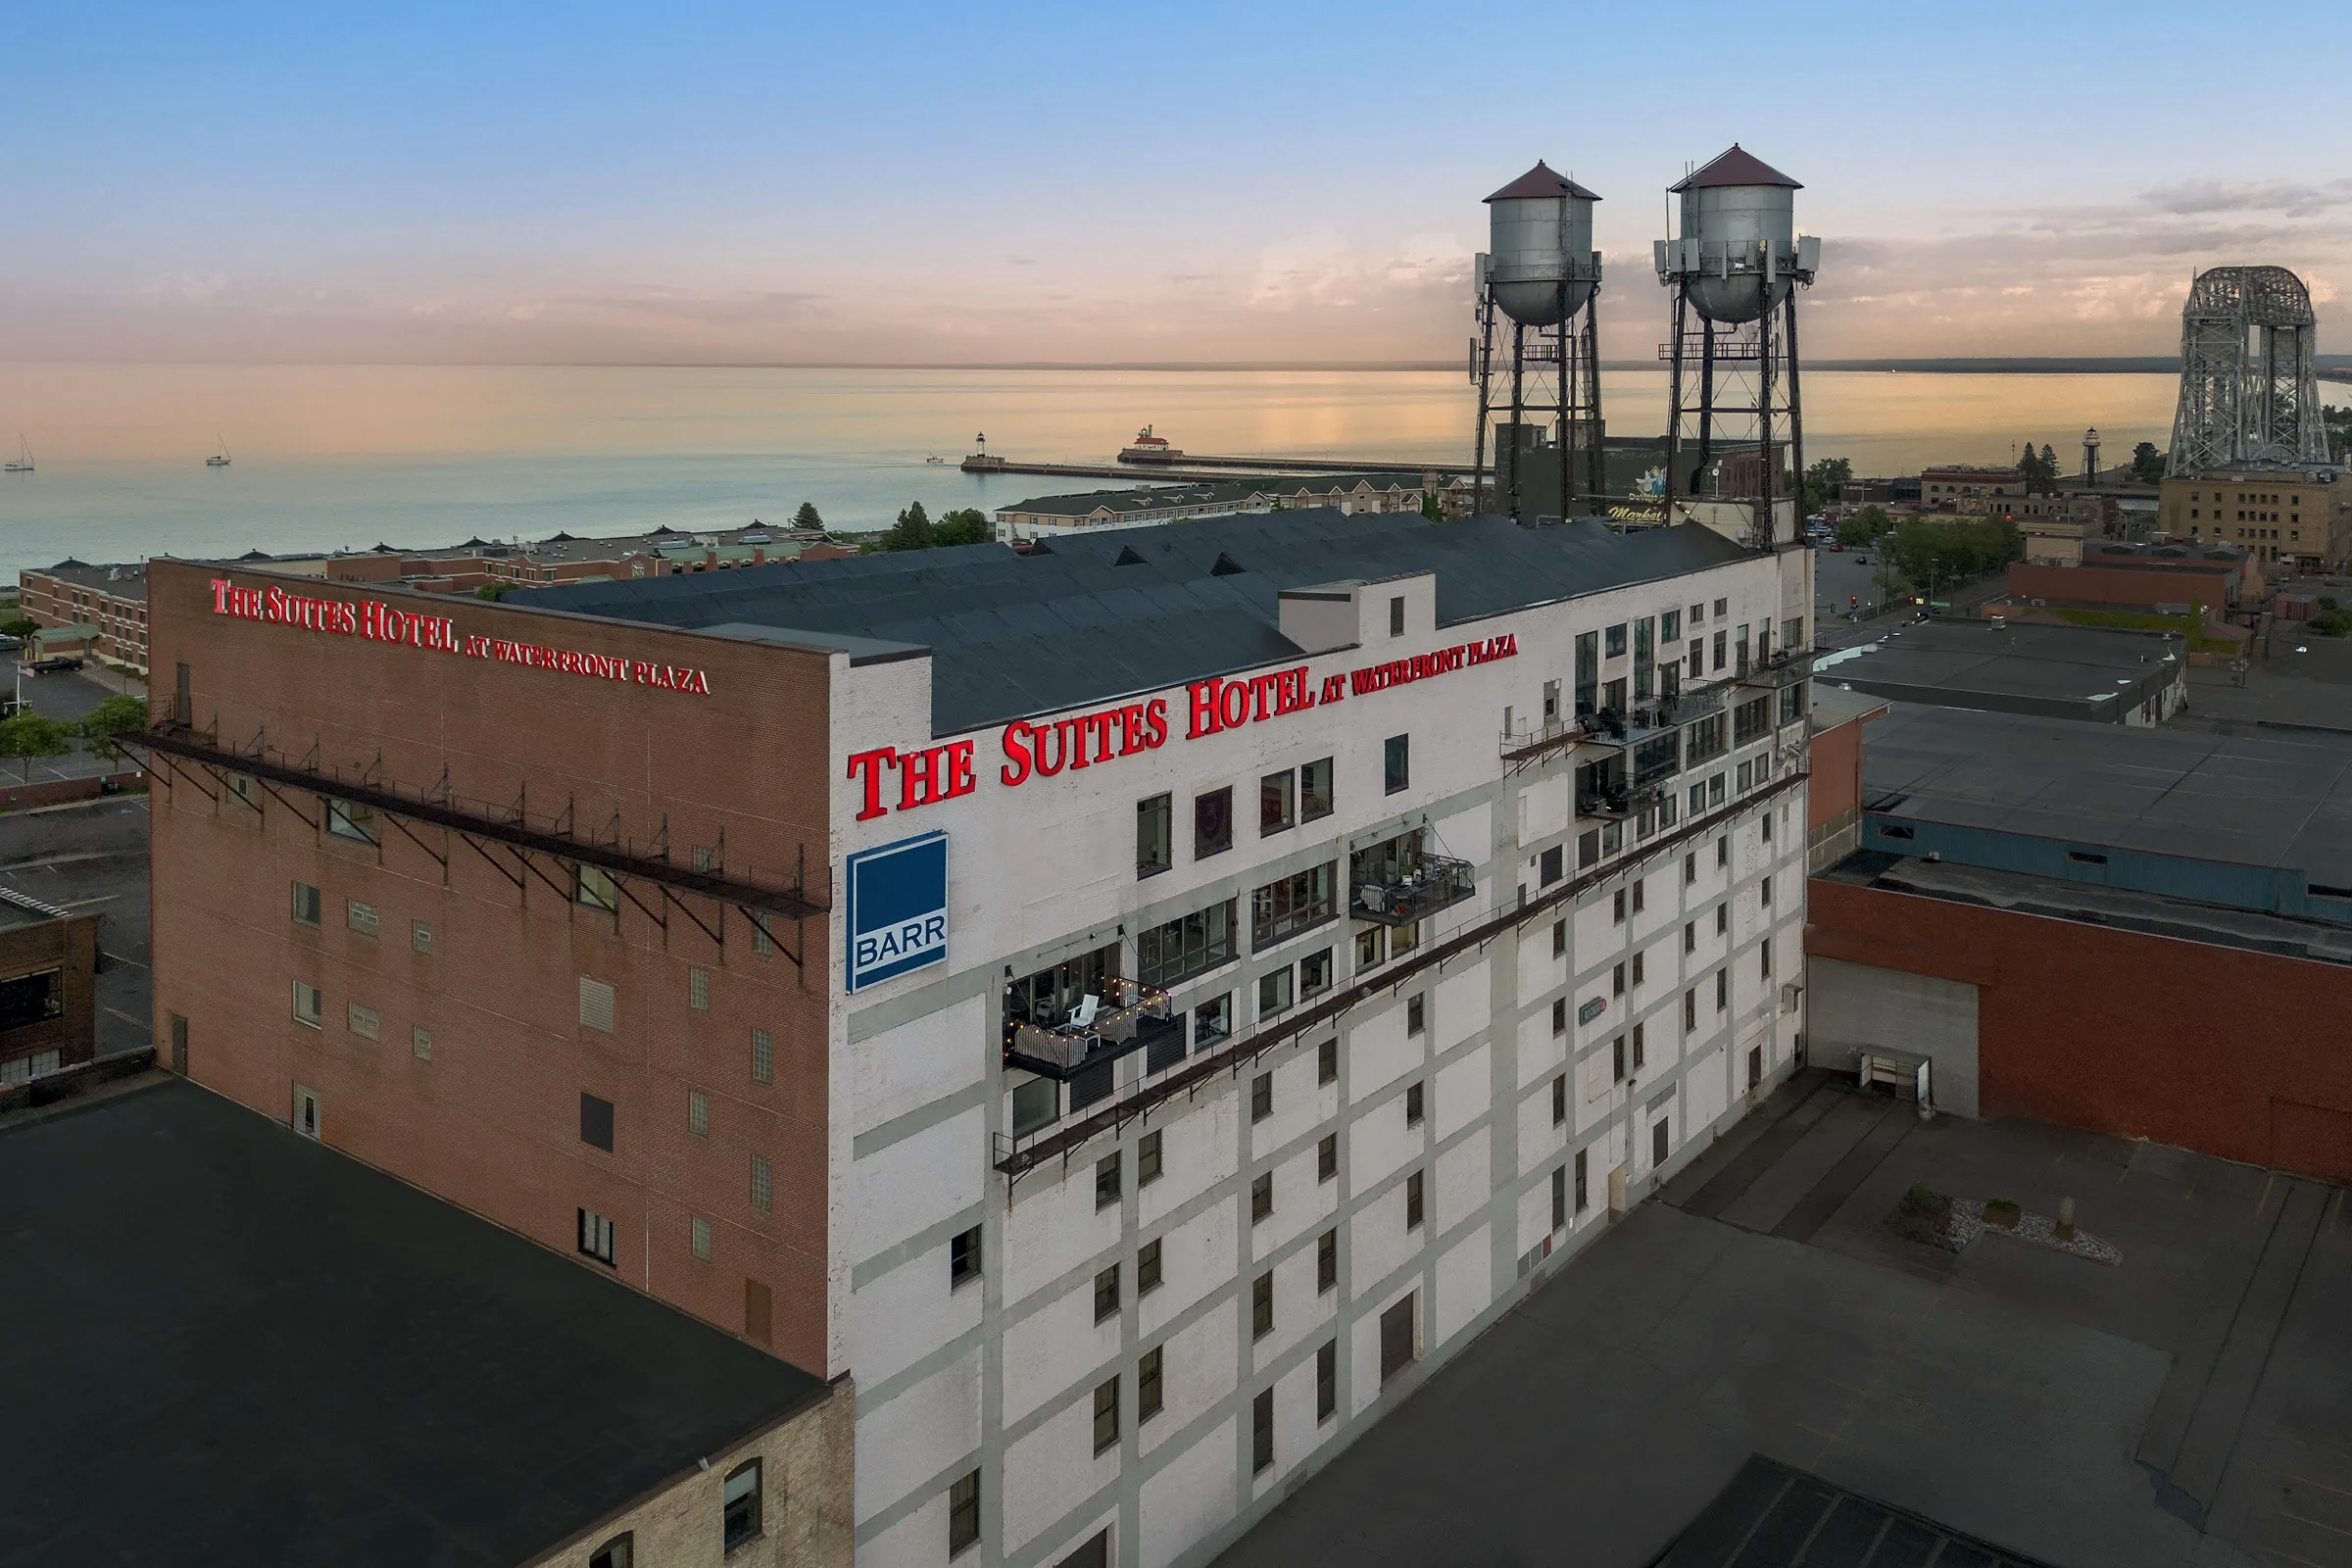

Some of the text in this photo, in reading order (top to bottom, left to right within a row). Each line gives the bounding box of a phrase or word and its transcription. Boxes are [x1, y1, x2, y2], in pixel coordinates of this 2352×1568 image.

[211, 578, 710, 695] THE SUITES HOTEL AT WATERFRONT PLAZA
[847, 633, 1519, 821] THE SUITES HOTEL AT WATERFRONT PLAZA
[856, 915, 946, 968] BARR
